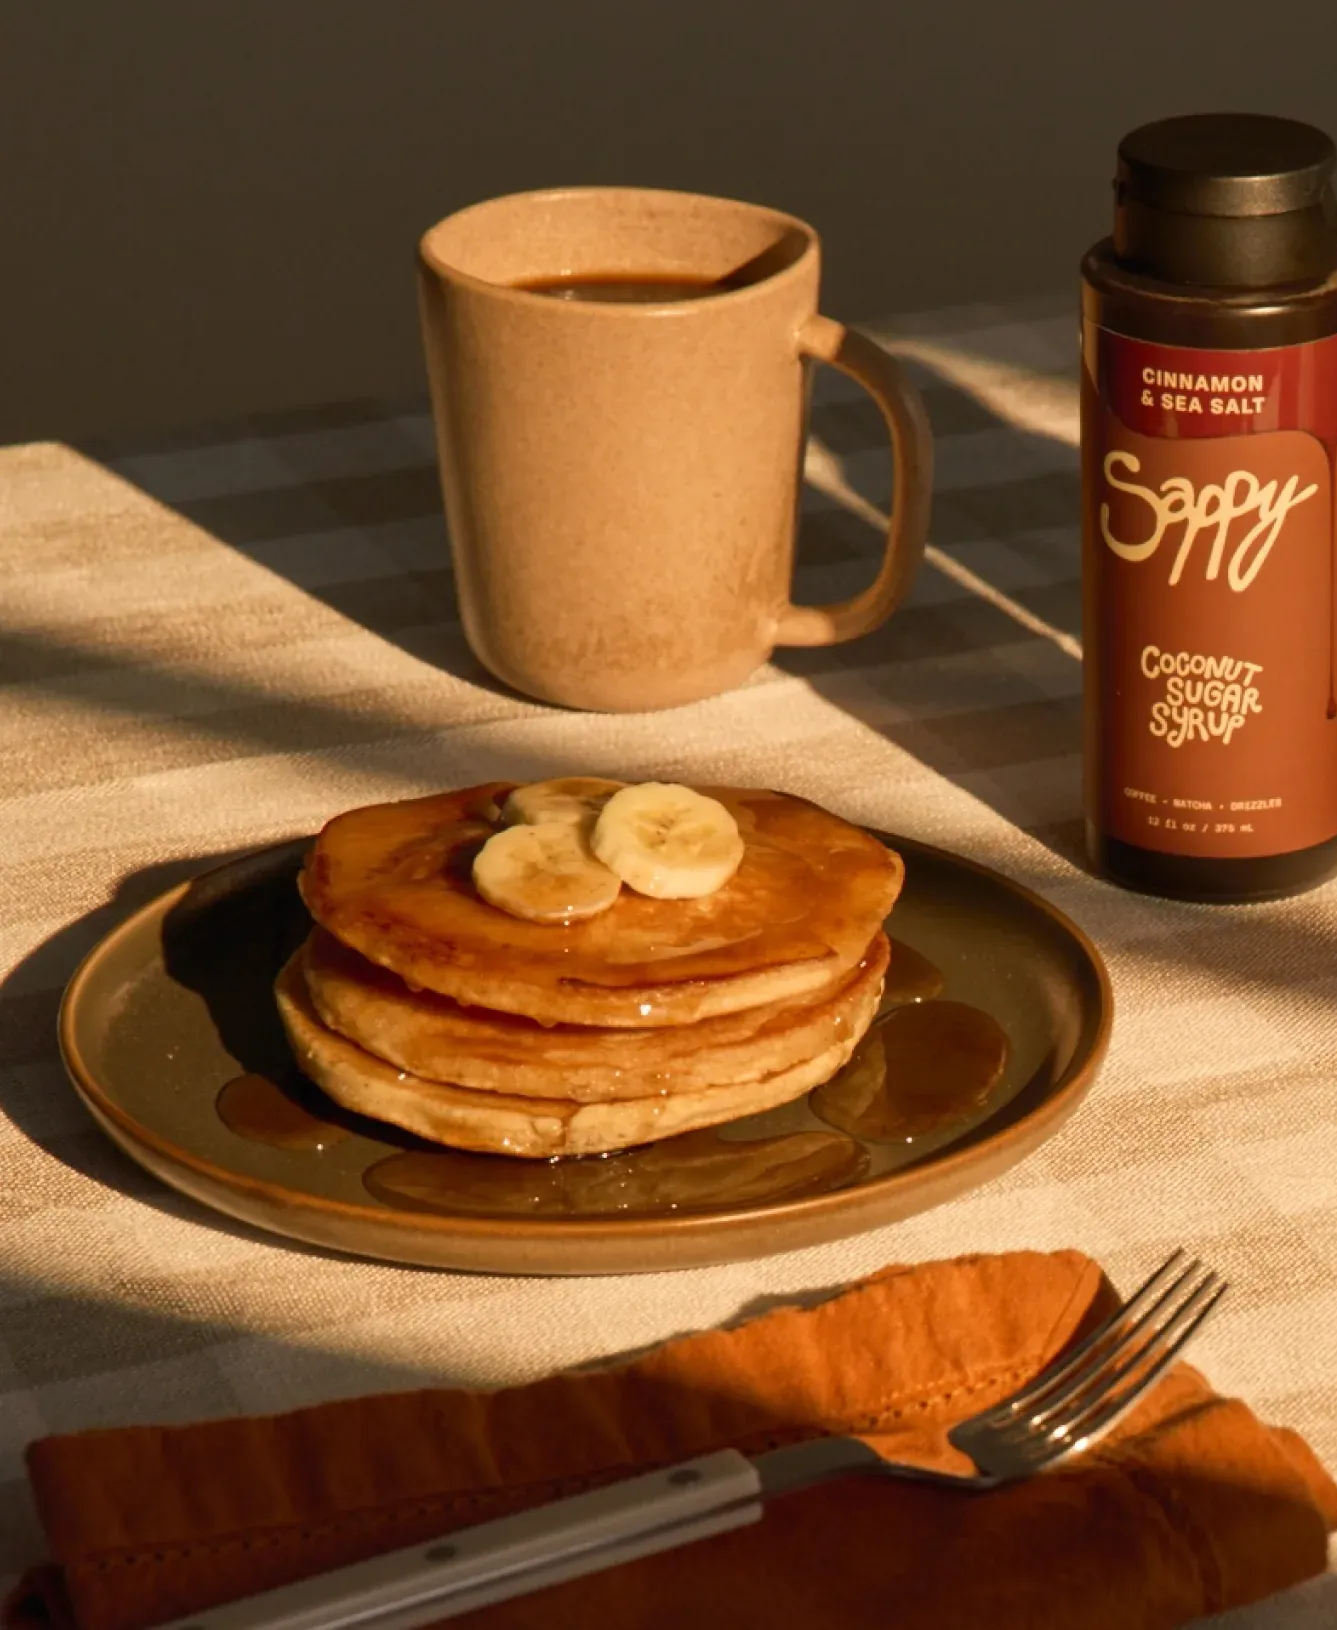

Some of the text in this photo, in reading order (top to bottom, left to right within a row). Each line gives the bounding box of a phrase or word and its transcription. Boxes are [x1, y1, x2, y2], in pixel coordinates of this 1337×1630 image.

[1142, 367, 1264, 392] CINNAMON
[1141, 389, 1265, 415] & SEA SALT
[1101, 451, 1318, 592] Sappy
[1141, 646, 1263, 686] COCONUT
[1166, 677, 1263, 714] SUGAR
[1173, 798, 1212, 811] MATCHA
[1230, 797, 1282, 812] DRIZZLES
